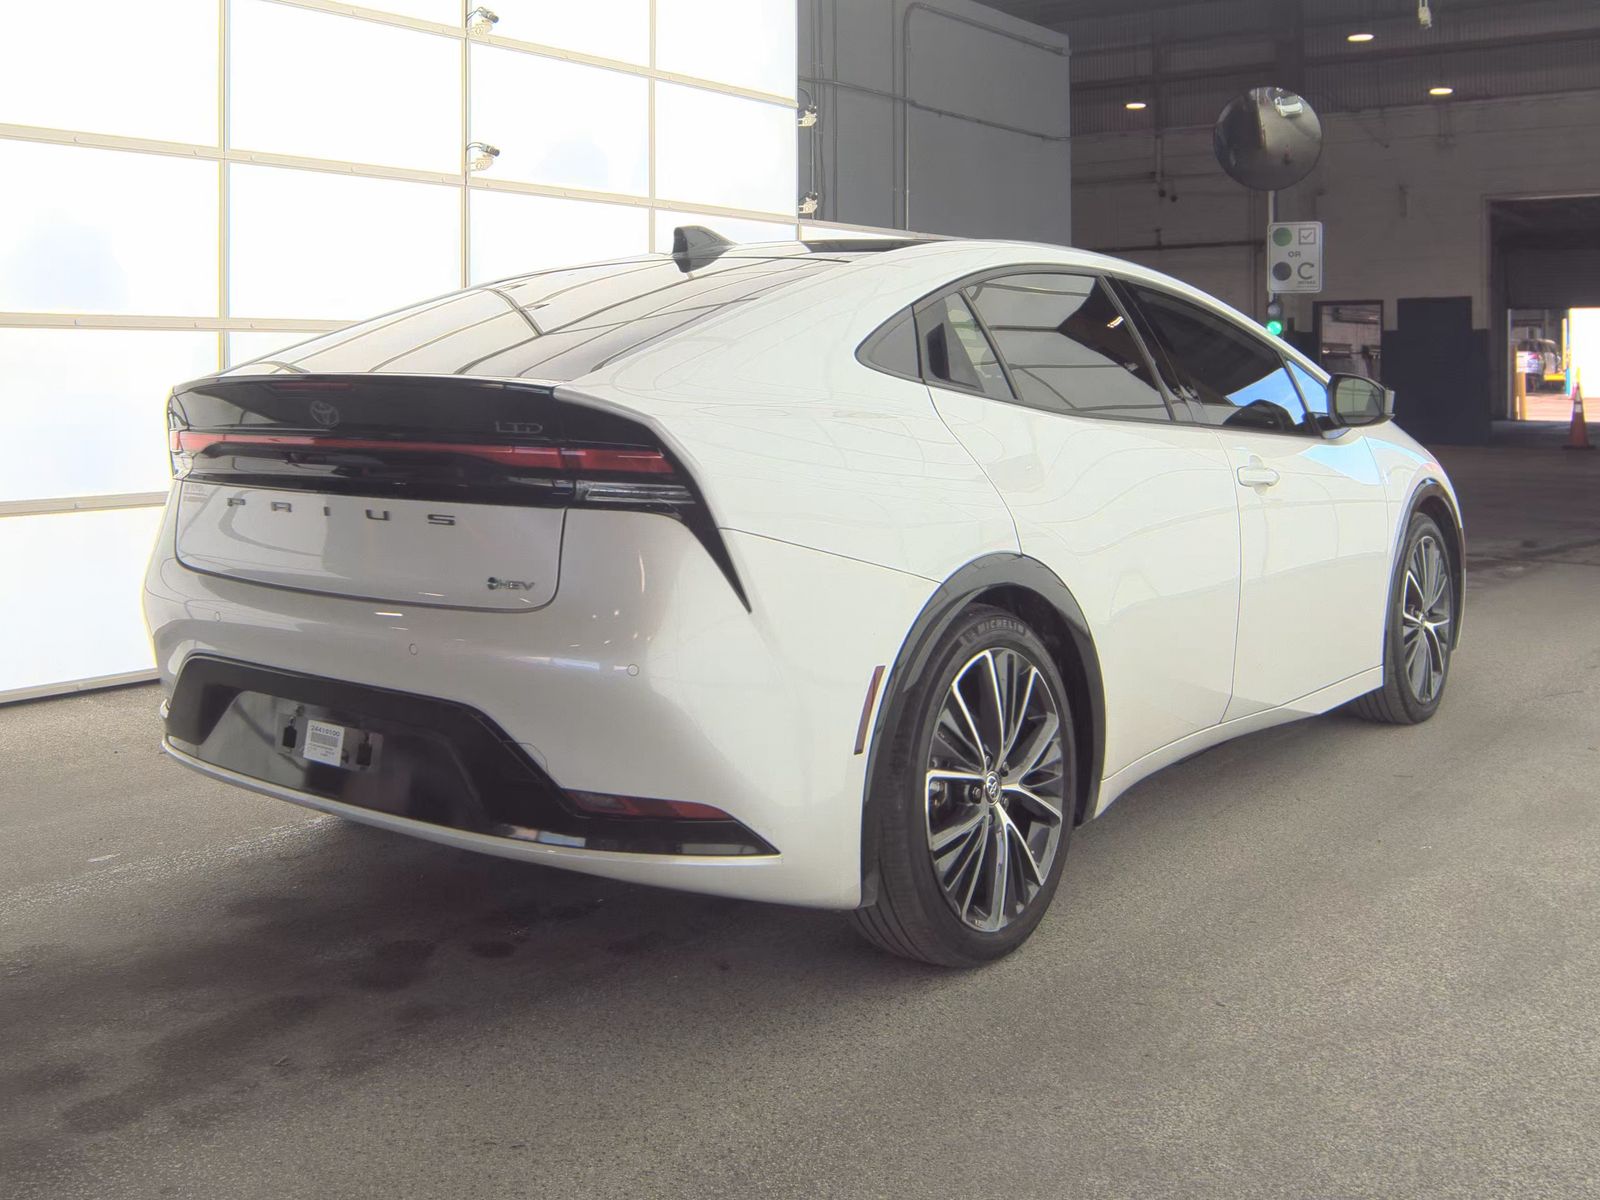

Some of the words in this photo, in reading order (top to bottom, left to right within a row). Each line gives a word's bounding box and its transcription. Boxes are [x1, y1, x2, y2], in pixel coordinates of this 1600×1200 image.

[1288, 250, 1301, 258] OR
[496, 421, 543, 434] LTD
[227, 497, 455, 526] PRIUS
[498, 580, 535, 591] HEV
[978, 619, 1024, 635] MICHELIN
